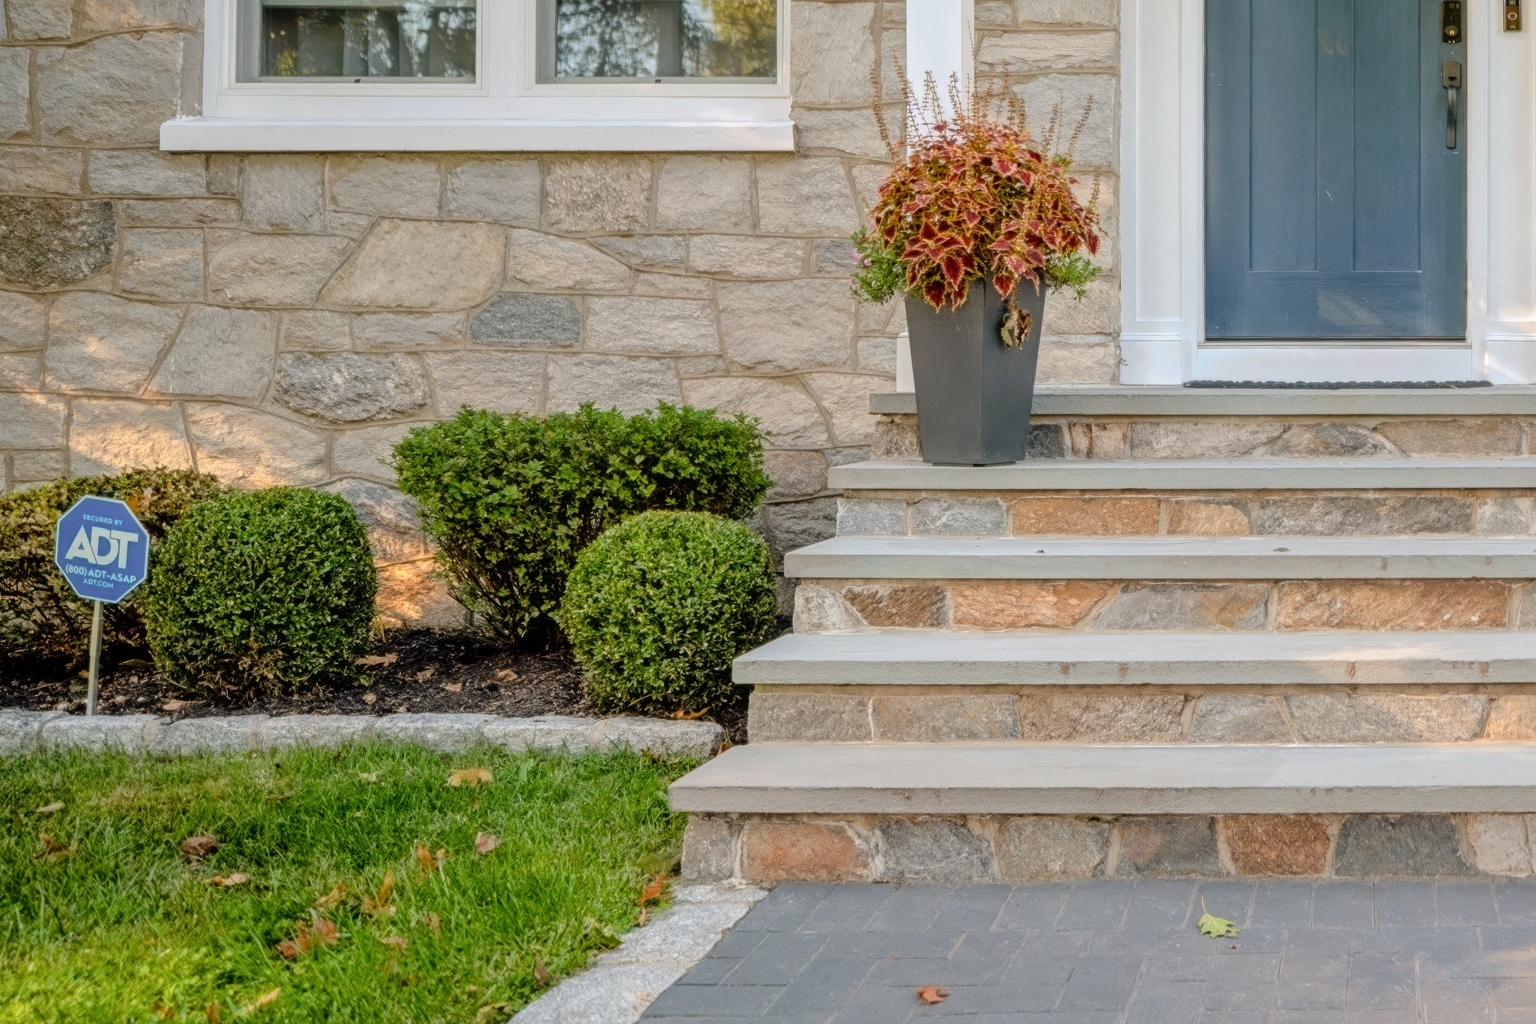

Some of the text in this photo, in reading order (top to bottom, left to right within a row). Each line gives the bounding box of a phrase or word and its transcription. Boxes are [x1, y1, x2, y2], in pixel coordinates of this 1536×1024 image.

[83, 514, 113, 524] SECURED
[65, 525, 139, 569] ADT
[65, 563, 136, 583] (800) ADT-ASAP
[83, 578, 114, 589] ADT.COM
